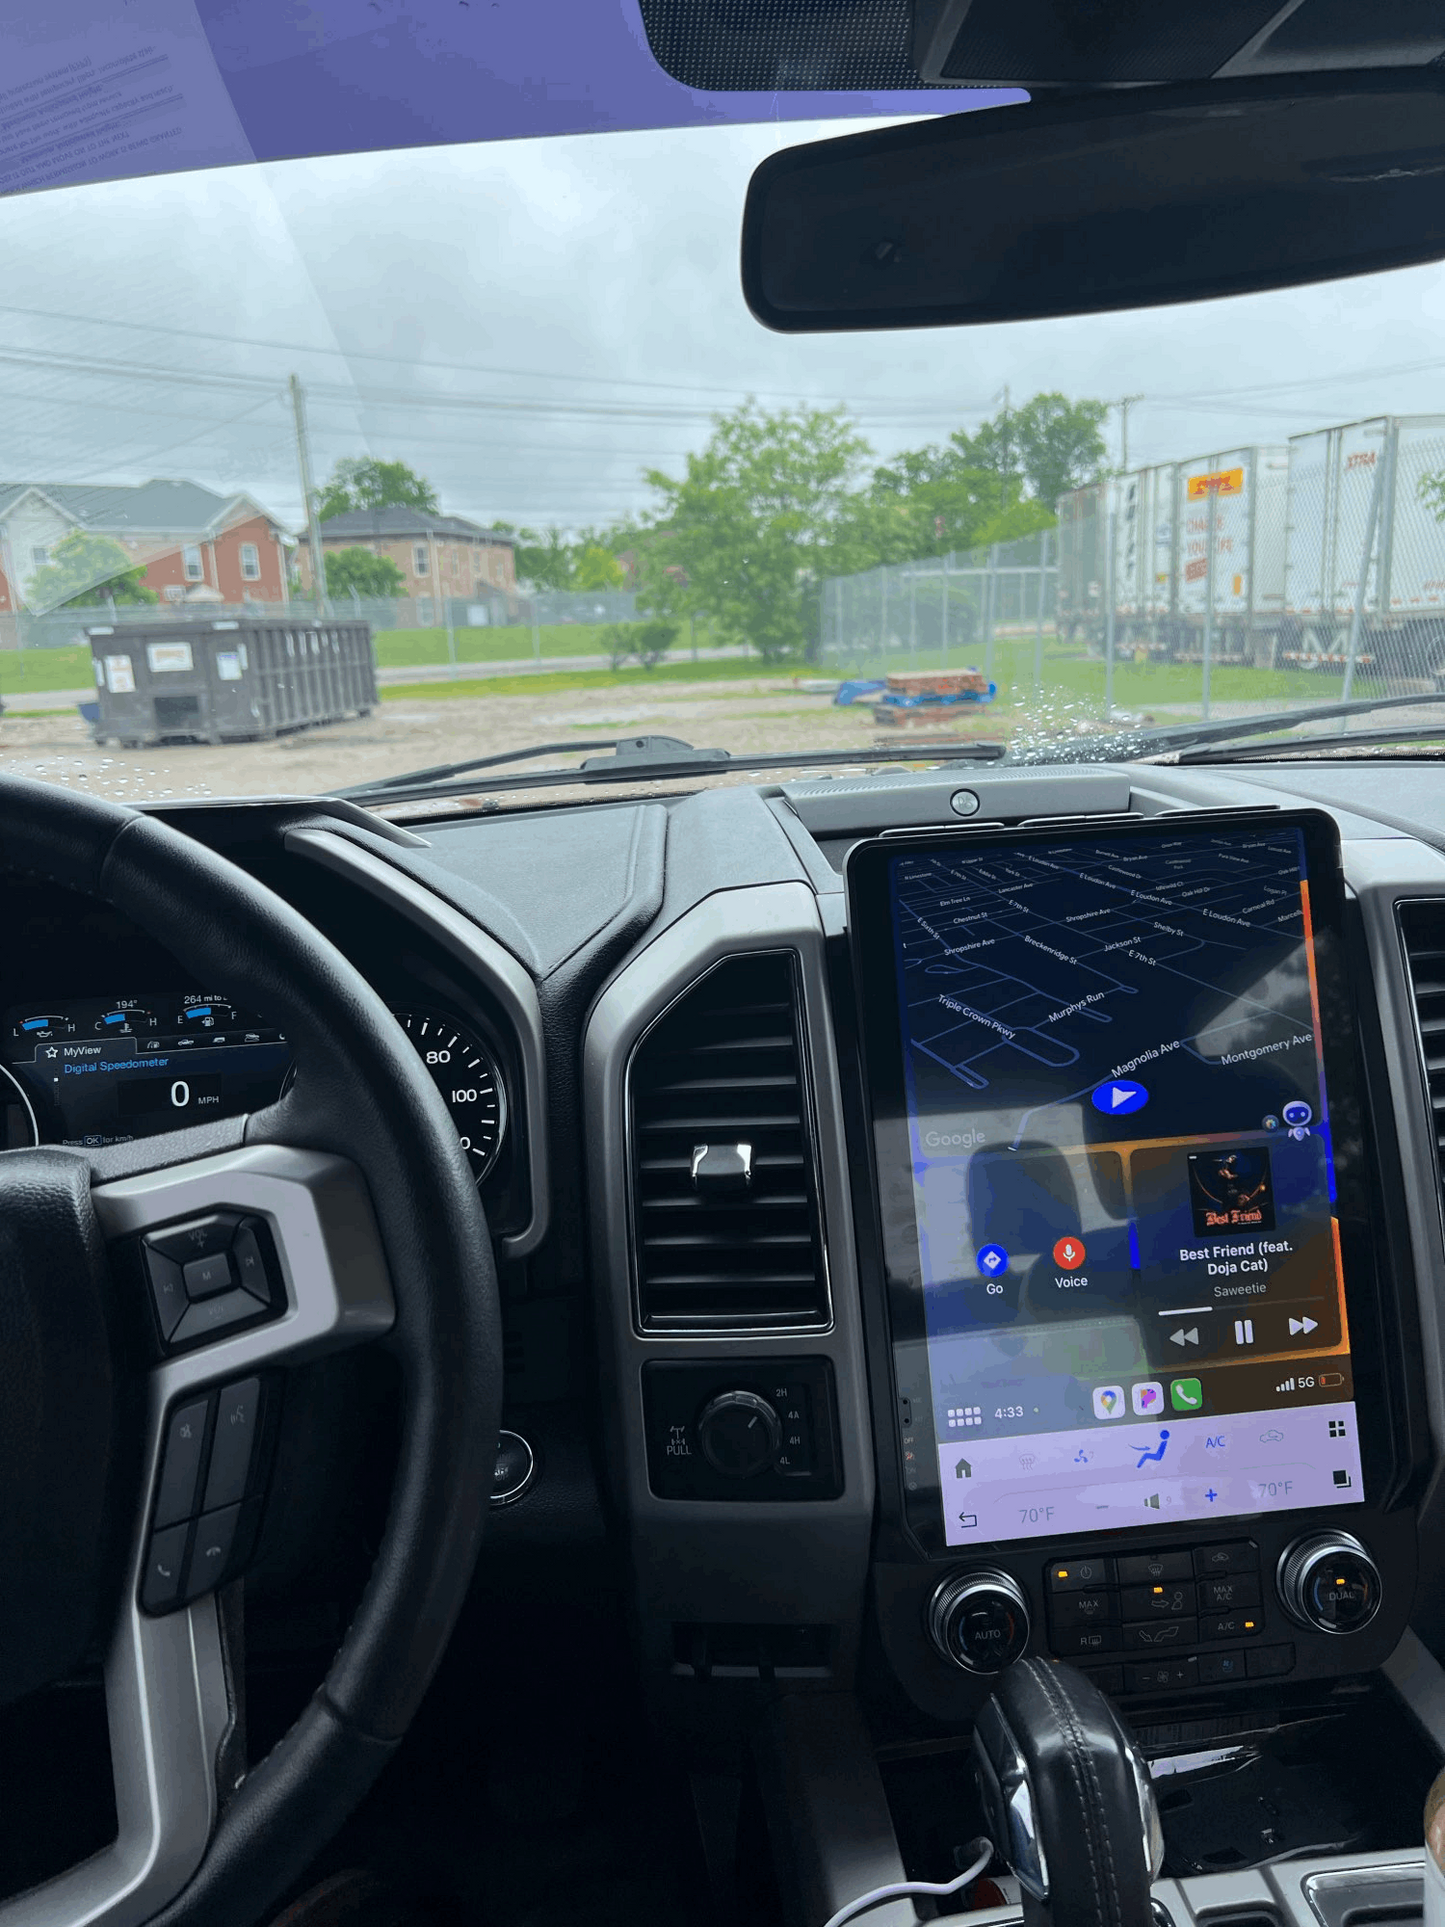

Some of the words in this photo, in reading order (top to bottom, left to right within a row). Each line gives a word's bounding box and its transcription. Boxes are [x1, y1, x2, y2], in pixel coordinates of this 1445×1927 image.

[1084, 874, 1104, 886] Loudon
[1104, 881, 1117, 890] Ave
[998, 885, 1023, 894] Lancaster
[1136, 892, 1160, 903] Loudon
[1160, 898, 1173, 906] Ave
[1013, 902, 1023, 910] 7th
[1023, 906, 1030, 914] St
[953, 913, 980, 924] Chestnut
[981, 911, 988, 919] St
[1066, 910, 1098, 923] Shropshire
[1202, 908, 1208, 916] E
[1208, 910, 1236, 924] Loudon
[1236, 918, 1251, 928] Ave
[921, 921, 934, 935] Sixth
[933, 931, 940, 940] St
[1153, 921, 1176, 935] Shelby
[1176, 929, 1184, 937] St
[944, 941, 981, 956] Shropshire
[981, 938, 996, 947] Ave
[1024, 935, 1069, 963] Breckenridge
[1068, 955, 1078, 965] St
[1104, 938, 1132, 952] Jackson
[1133, 936, 1142, 944] St
[1128, 949, 1134, 957] E
[1135, 952, 1148, 963] 7th
[1148, 958, 1157, 967] St
[184, 994, 202, 1004] 264
[204, 994, 213, 1002] mi
[1048, 999, 1087, 1024] Murphys
[1086, 991, 1105, 1005] Run
[149, 1017, 157, 1026] H
[177, 1015, 184, 1024] E
[231, 1011, 237, 1020] F
[938, 993, 962, 1012] Triple
[962, 1007, 992, 1027] Crown
[991, 1021, 1016, 1040] Pkwy
[13, 1027, 19, 1037] L
[67, 1023, 76, 1033] H
[94, 1021, 102, 1031] C
[64, 1046, 102, 1057] MyView
[1220, 1040, 1290, 1066] Montgomery
[1292, 1032, 1313, 1046] Ave
[426, 1050, 451, 1065] 80
[1110, 1047, 1160, 1078] Magnolia
[1159, 1039, 1181, 1055] Ave
[64, 1062, 97, 1075] Digital
[100, 1057, 169, 1072] Speedometer
[170, 1081, 190, 1107] 0
[198, 1095, 220, 1105] MPH
[452, 1089, 478, 1103] 100
[86, 1137, 99, 1145] OK
[925, 1127, 986, 1148] Google
[188, 1228, 208, 1241] VOL
[1179, 1248, 1211, 1262] Best
[1213, 1243, 1255, 1258] Friend
[1258, 1240, 1293, 1256] (feat.
[1207, 1262, 1238, 1277] Doja
[1240, 1258, 1269, 1273] Cat)
[202, 1271, 212, 1281] M
[1054, 1276, 1088, 1289] Voice
[986, 1283, 1004, 1295] Go
[1213, 1282, 1267, 1298] Saweetie
[1297, 1376, 1315, 1389] 5G
[775, 1388, 788, 1398] 2H
[788, 1411, 800, 1420] 4A
[994, 1405, 1024, 1419] 4:33
[789, 1436, 801, 1445] 4H
[1205, 1435, 1226, 1449] A/C
[666, 1445, 692, 1456] PULL
[780, 1456, 791, 1465] 4L
[1258, 1480, 1294, 1498] 70°F
[1019, 1506, 1055, 1524] 70°F
[1213, 1586, 1233, 1594] MAX
[1216, 1592, 1233, 1601] A/C
[1328, 1591, 1355, 1601] DUAL
[1078, 1600, 1099, 1609] MAX
[1217, 1621, 1235, 1631] A/C
[974, 1629, 1001, 1640] AUTO
[1080, 1637, 1088, 1646] R
